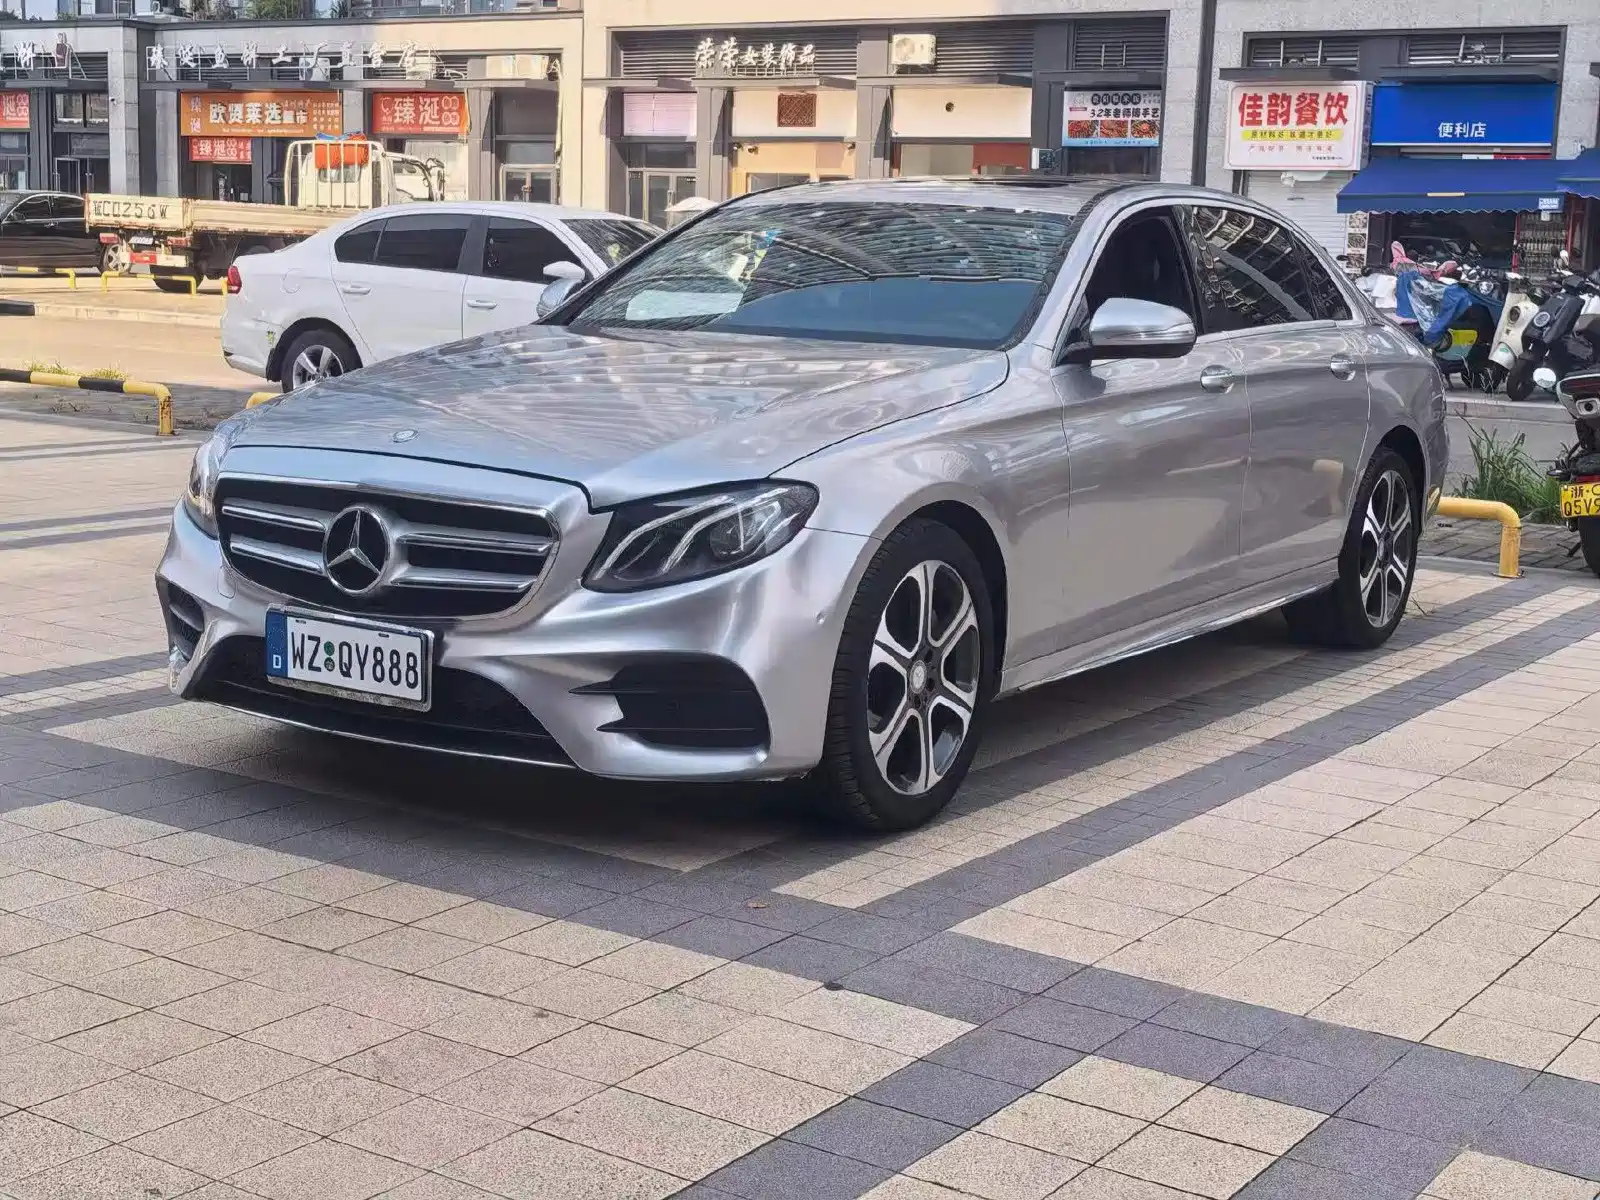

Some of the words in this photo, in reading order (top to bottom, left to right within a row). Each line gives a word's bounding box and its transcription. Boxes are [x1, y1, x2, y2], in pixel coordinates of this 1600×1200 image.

[695, 36, 815, 70] 荣荣女装饰品
[1238, 92, 1349, 127] 佳韵餐饮
[1438, 121, 1487, 139] 便利店
[291, 631, 322, 673] WZ
[338, 641, 419, 690] QY888
